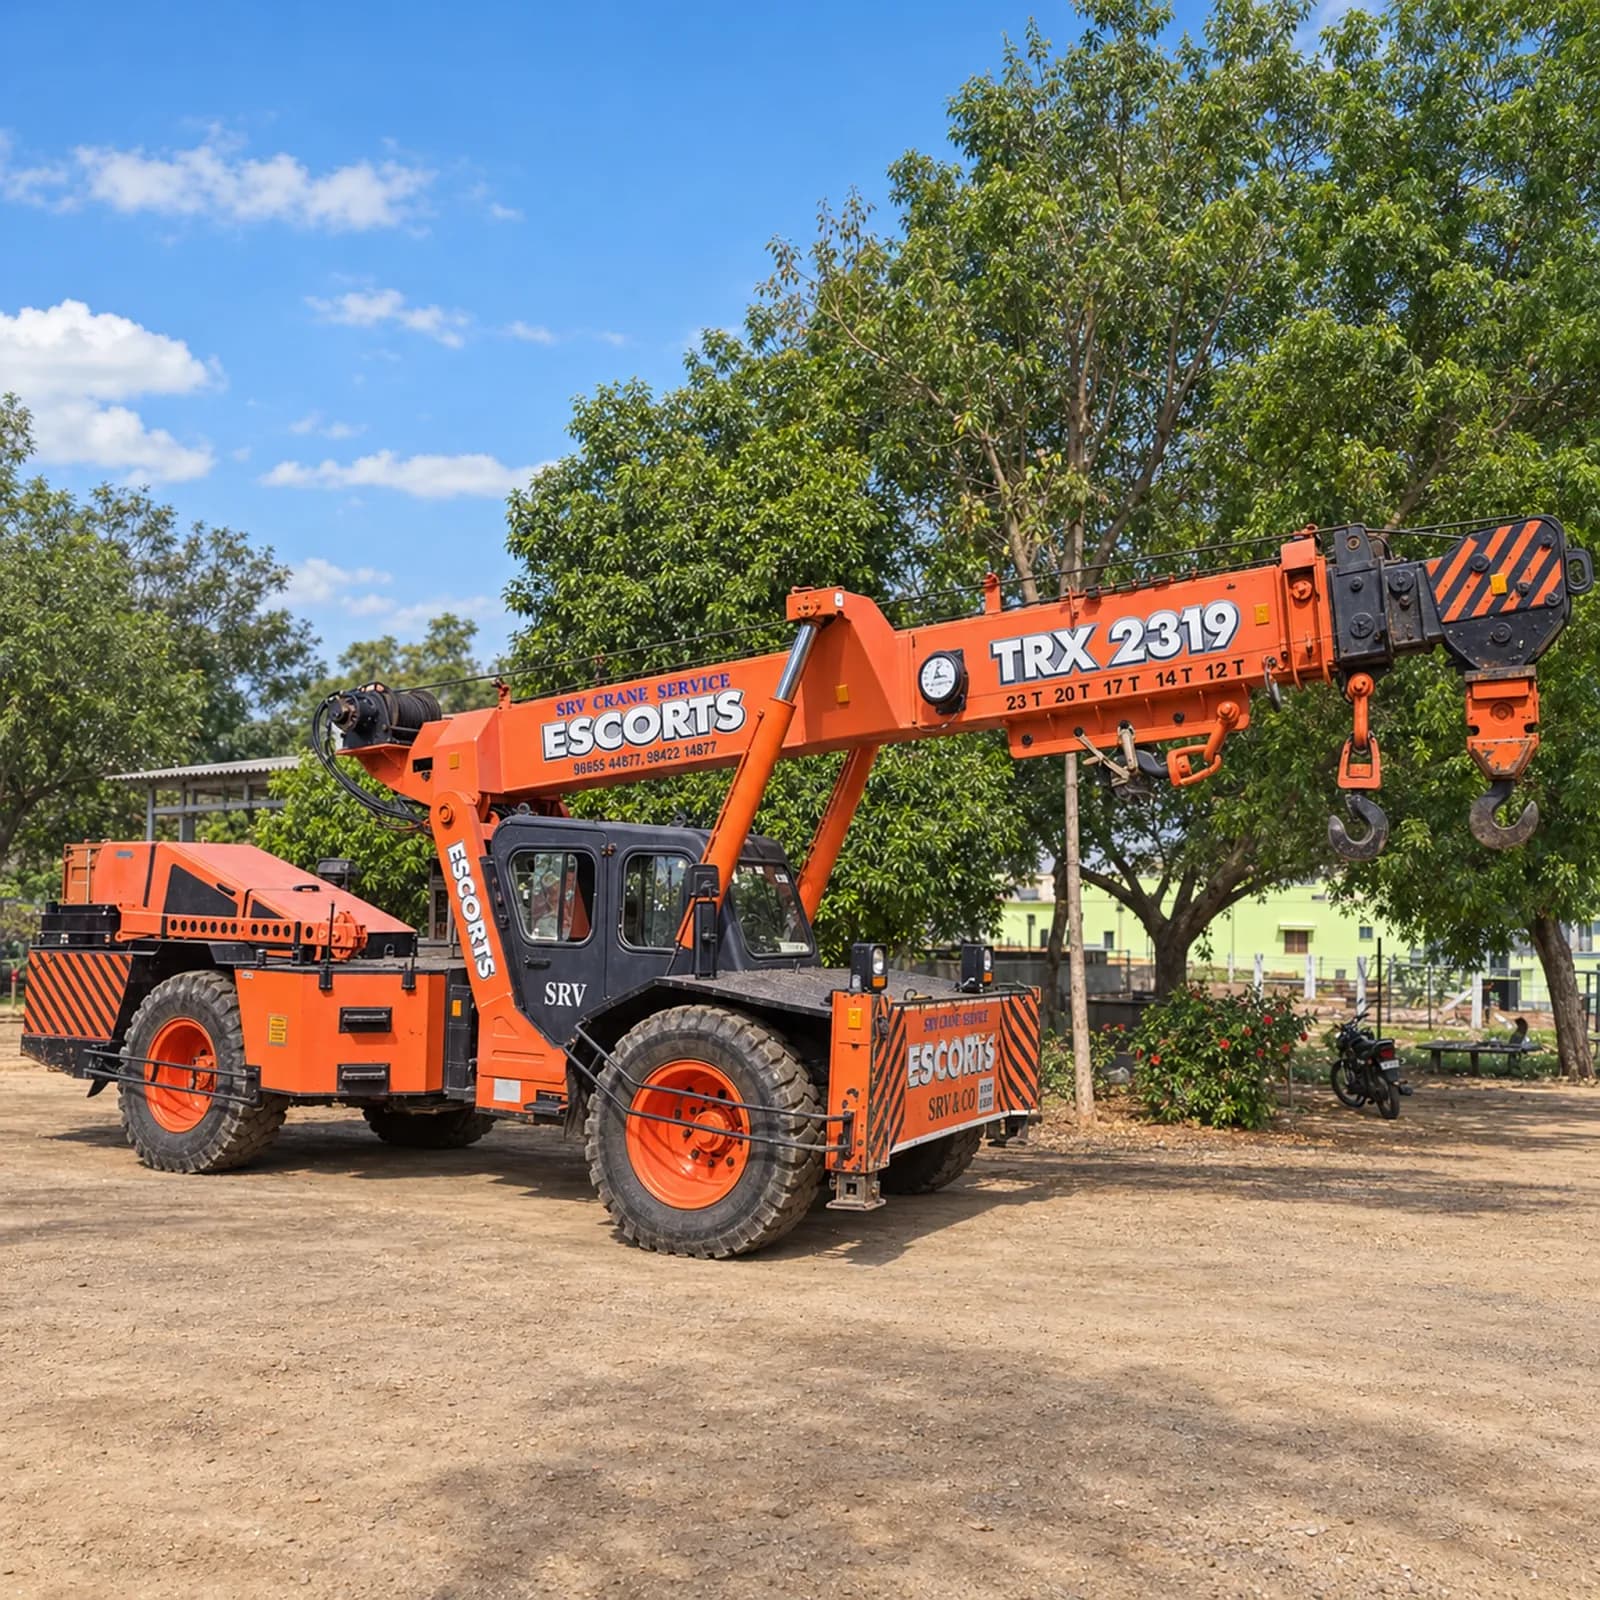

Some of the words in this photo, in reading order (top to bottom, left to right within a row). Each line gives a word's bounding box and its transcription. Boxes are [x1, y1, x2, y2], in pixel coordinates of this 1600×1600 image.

[990, 624, 1100, 685] TRX
[1108, 600, 1239, 668] 2319
[556, 698, 586, 717] SRV
[593, 687, 649, 710] CRANE
[657, 673, 731, 699] SERVICE
[1006, 695, 1026, 711] 23
[1031, 691, 1043, 707] T
[1054, 687, 1075, 704] 20
[1079, 683, 1090, 699] T
[1103, 679, 1123, 695] 17
[1128, 676, 1140, 692] T
[1155, 670, 1177, 688] 14
[1181, 667, 1193, 684] T
[1205, 662, 1228, 681] 12
[1232, 659, 1244, 676] T
[542, 690, 745, 760] ESCORTS
[646, 746, 680, 763] 98422
[684, 741, 717, 757] 14877
[447, 840, 496, 980] ESCORTS
[544, 981, 588, 1007] SRV
[907, 1033, 995, 1088] ESCORTS
[928, 1092, 951, 1121] SRV
[952, 1091, 959, 1115] &
[961, 1087, 976, 1112] CO
